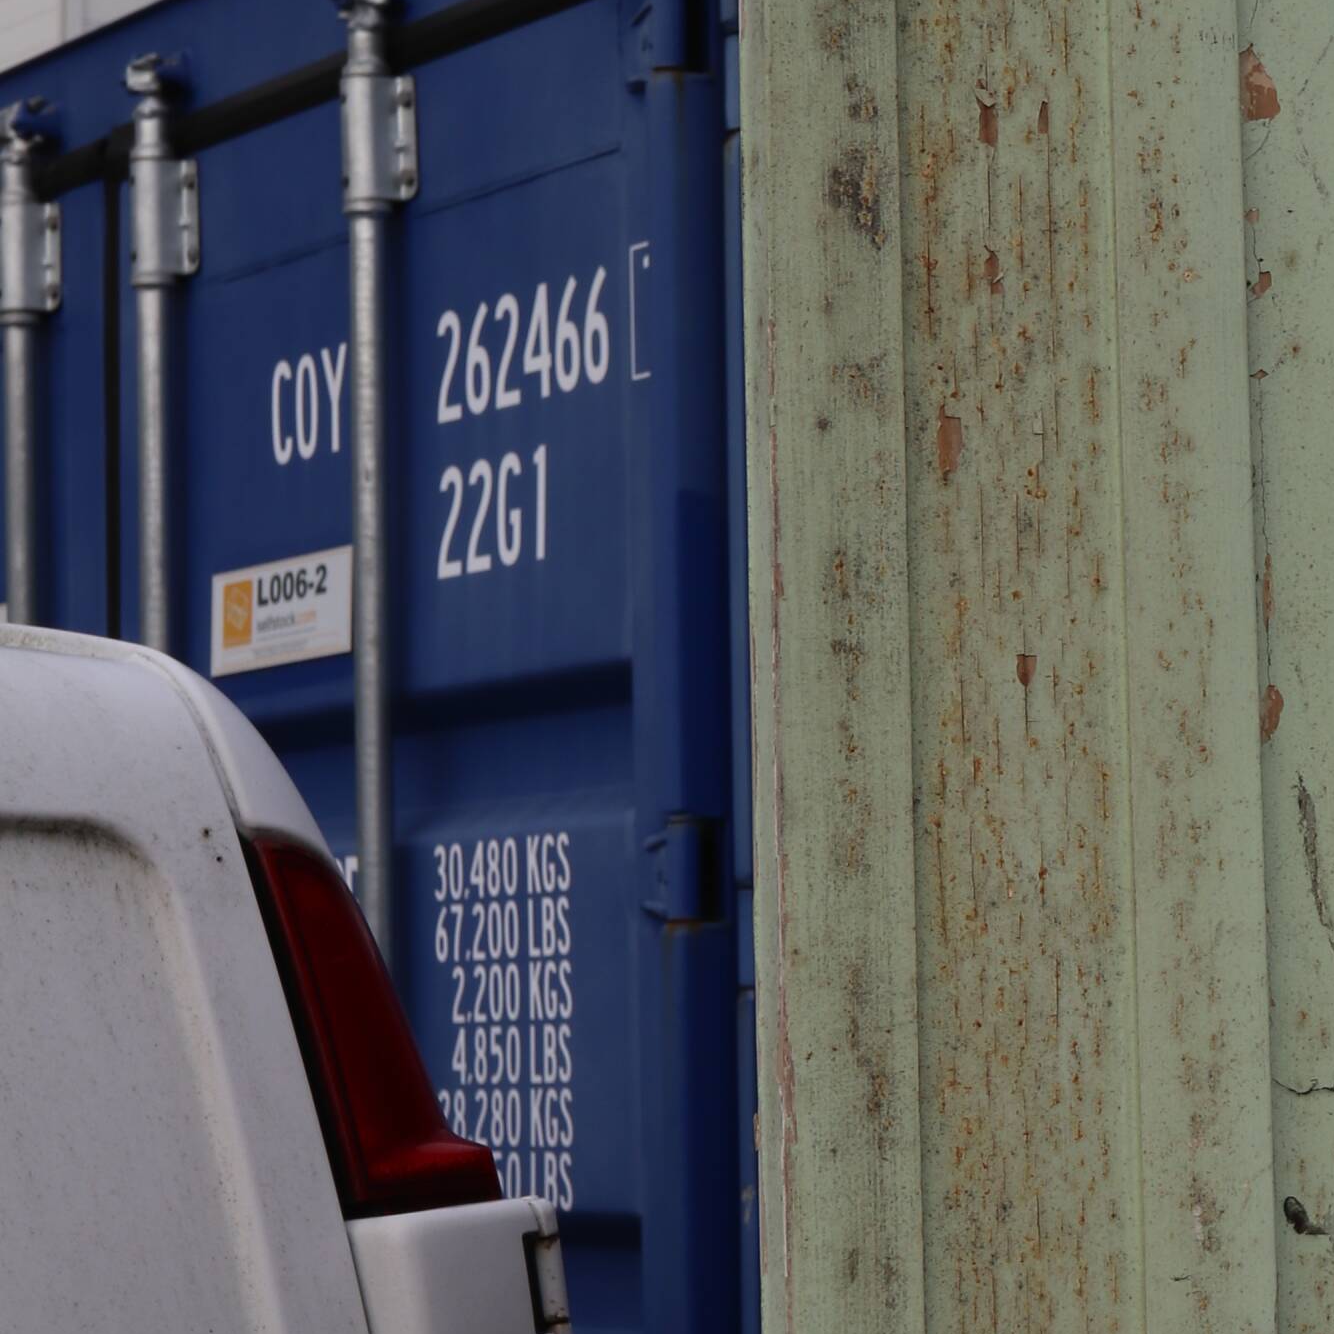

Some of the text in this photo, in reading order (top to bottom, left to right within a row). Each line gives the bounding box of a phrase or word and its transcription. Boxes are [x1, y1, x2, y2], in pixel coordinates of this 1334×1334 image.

[437, 265, 610, 425] 262466
[437, 443, 547, 580] 22G1
[257, 563, 328, 607] L006-2
[526, 832, 571, 895] KGS
[527, 896, 571, 958] LBS
[529, 959, 573, 1021] KGS
[529, 1023, 573, 1084] LBS
[530, 1087, 574, 1148] KGS
